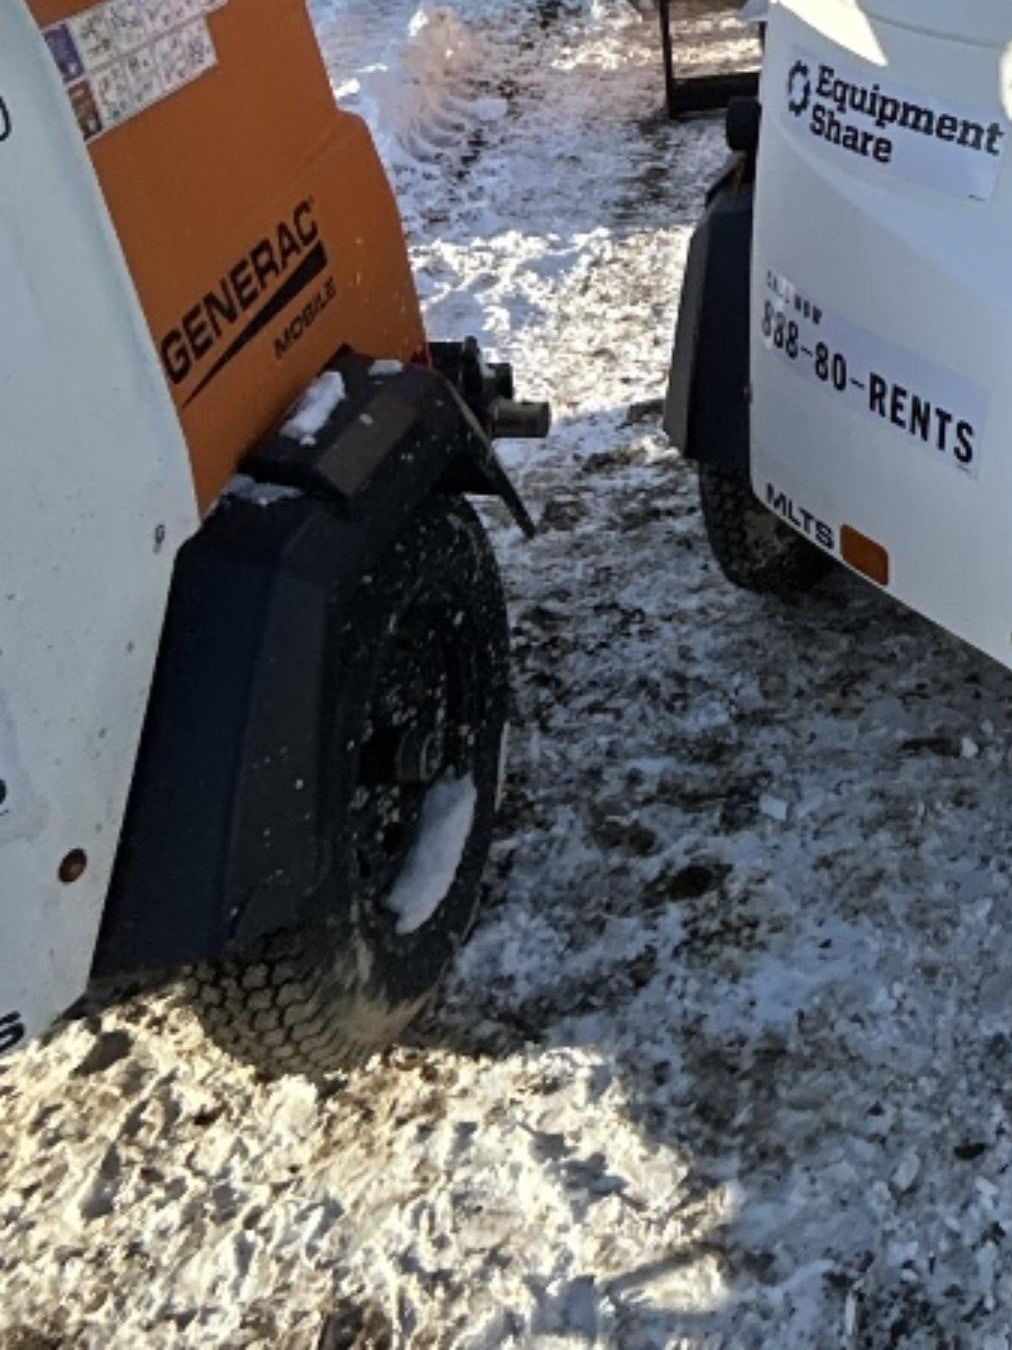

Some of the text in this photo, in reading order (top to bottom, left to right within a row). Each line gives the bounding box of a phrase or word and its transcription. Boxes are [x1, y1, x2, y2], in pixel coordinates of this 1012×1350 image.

[809, 103, 893, 164] Share
[815, 65, 1005, 156] Equipment
[161, 199, 318, 384] GENERAC
[272, 275, 337, 360] MOBILE
[761, 298, 976, 465] 888-80-RENTS
[766, 482, 835, 550] MLTS
